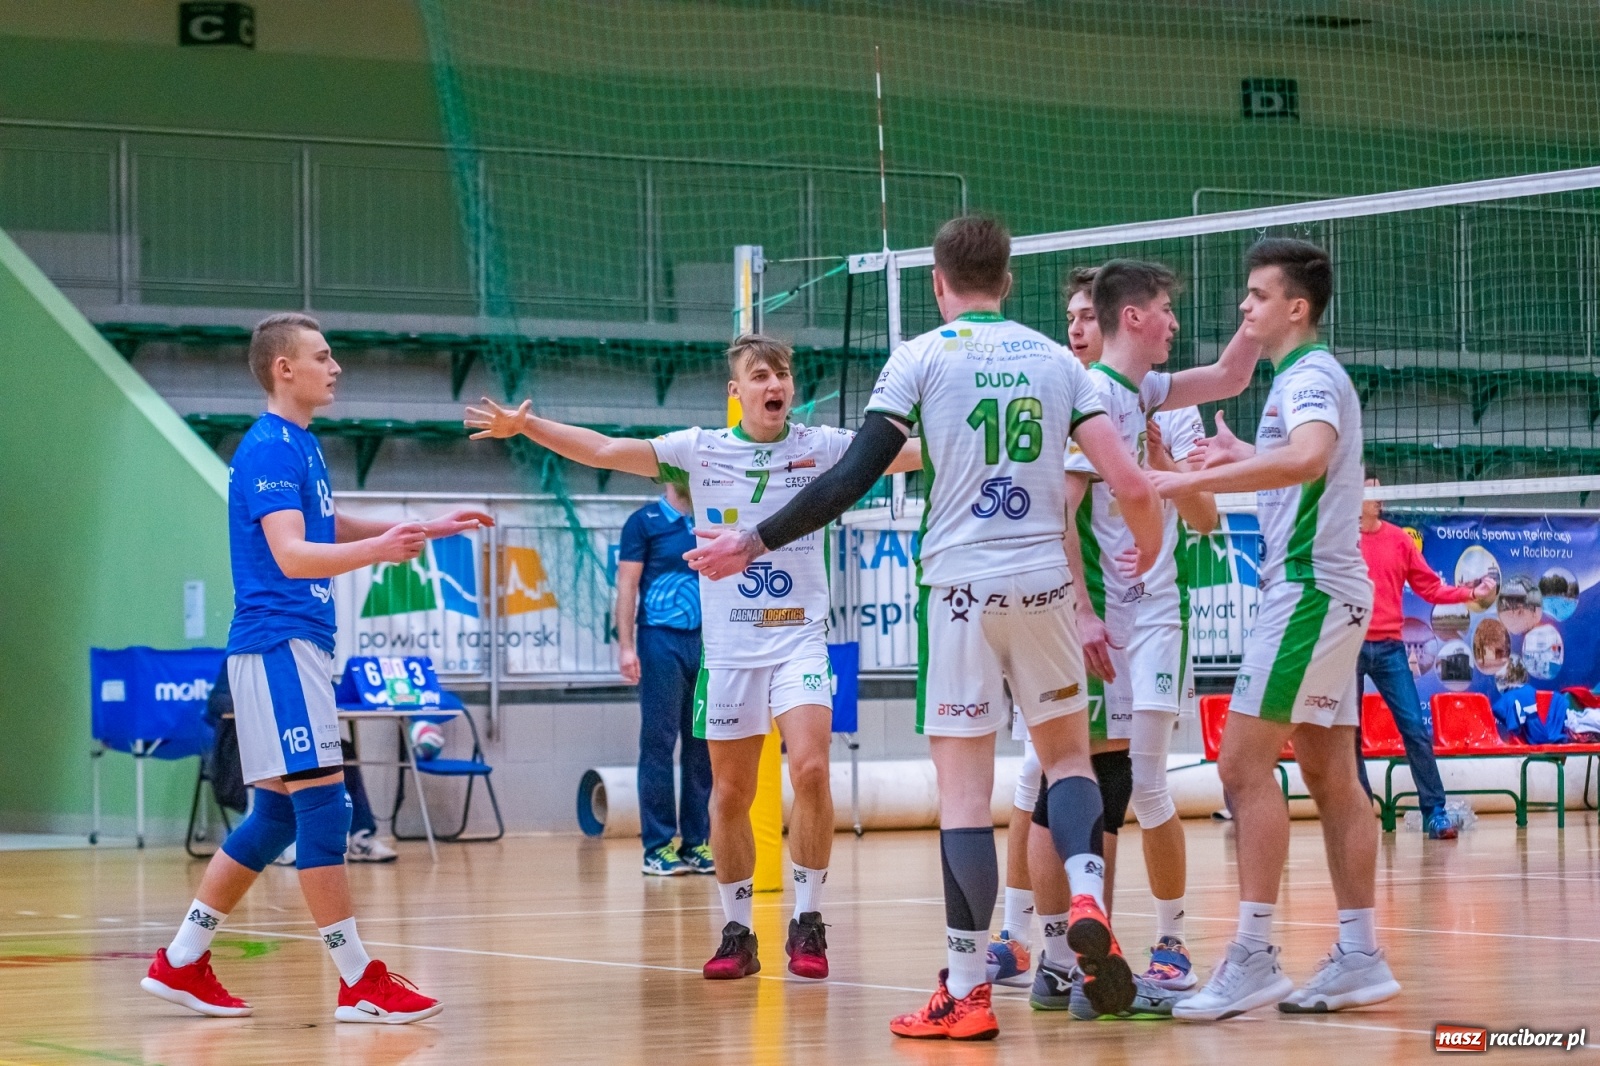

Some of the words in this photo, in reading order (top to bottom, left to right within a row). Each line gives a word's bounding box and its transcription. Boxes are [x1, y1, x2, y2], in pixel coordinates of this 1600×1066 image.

[188, 15, 225, 41] C
[1251, 91, 1284, 112] D
[964, 339, 1051, 353] eco-team
[975, 371, 1031, 388] DUDA
[966, 396, 1043, 466] 16
[745, 470, 770, 504] 7
[1510, 549, 1520, 558] w
[1523, 546, 1573, 559] Raciborzu
[359, 626, 441, 652] powiat
[363, 661, 382, 687] 6
[408, 661, 427, 686] 3
[695, 698, 705, 722] 7
[937, 701, 990, 718] BTSPORT
[1087, 695, 1104, 721] 7
[282, 726, 311, 755] 18
